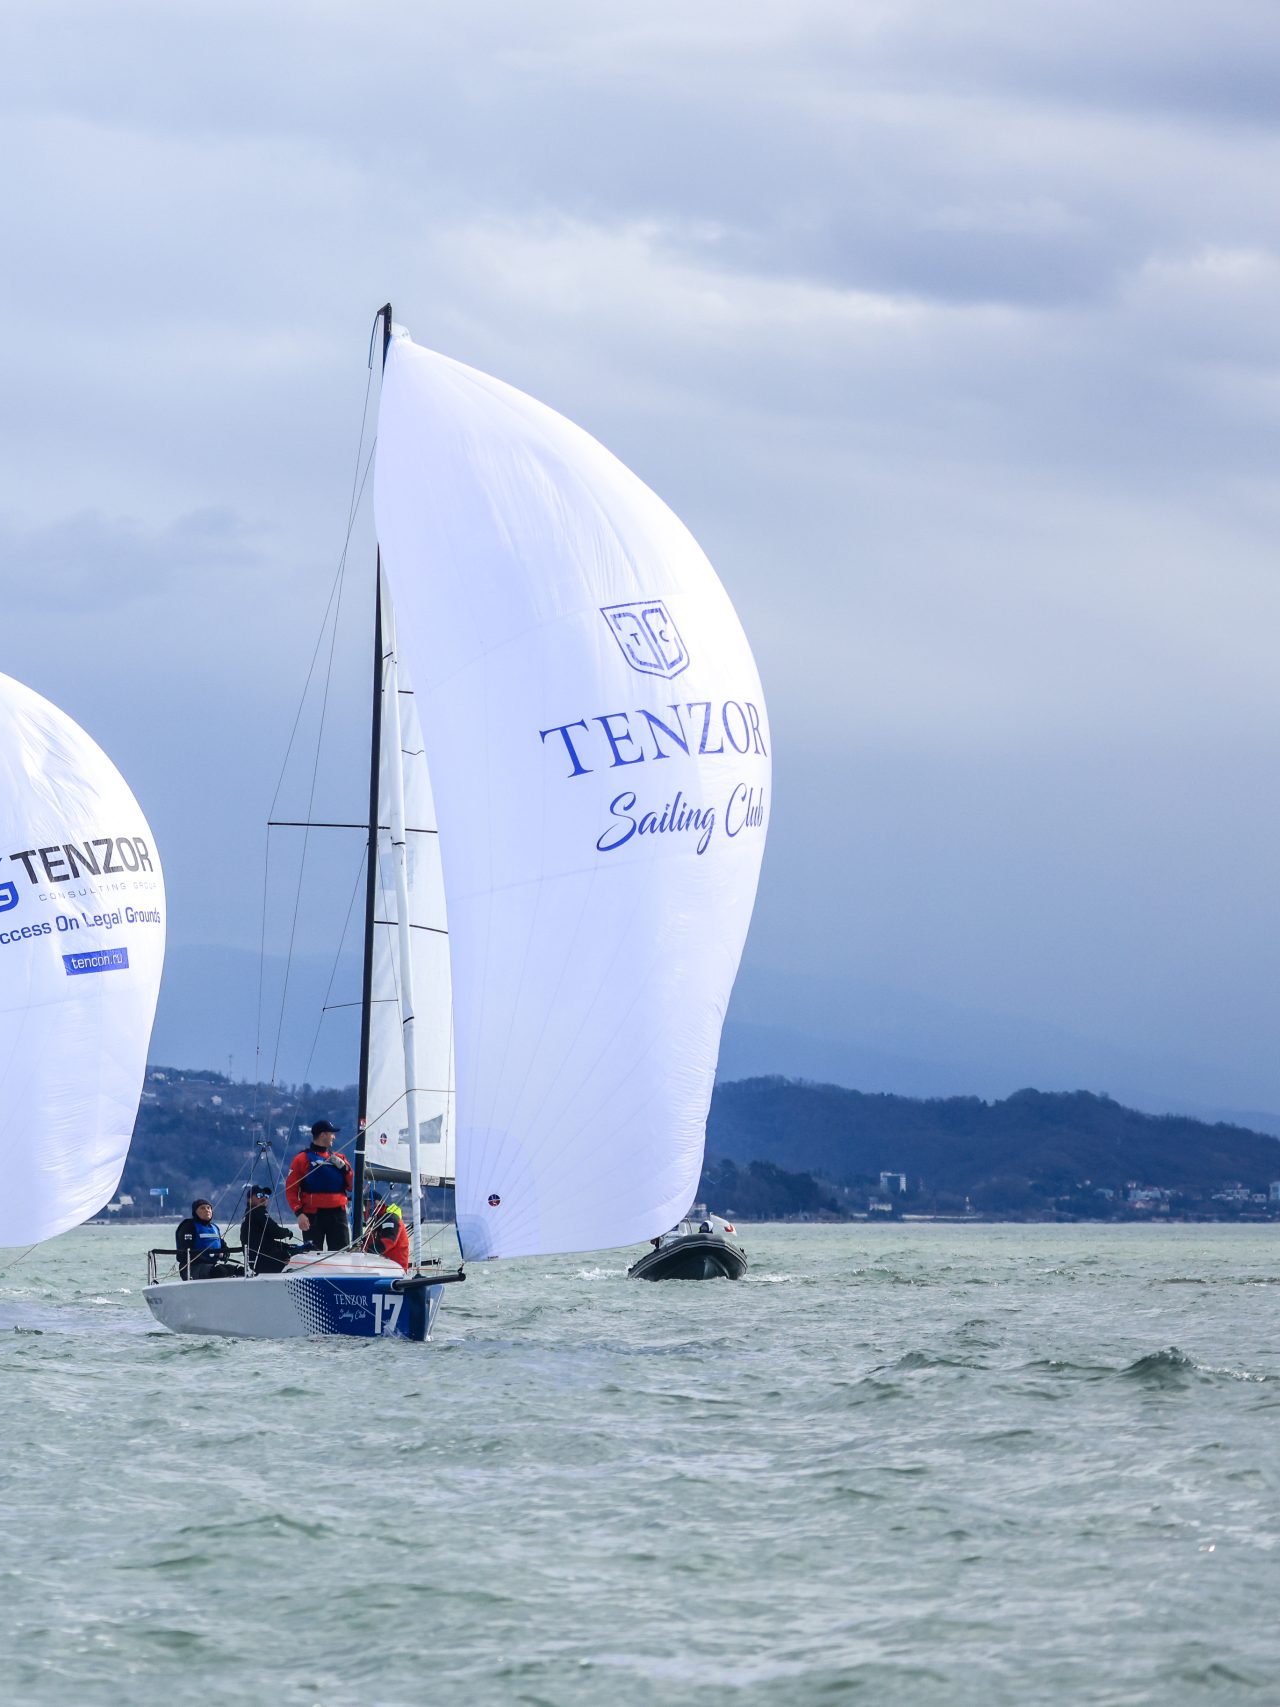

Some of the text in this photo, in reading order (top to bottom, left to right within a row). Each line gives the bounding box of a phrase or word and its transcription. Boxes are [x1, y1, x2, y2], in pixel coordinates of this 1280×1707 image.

[539, 700, 767, 779] TENZOR
[596, 782, 764, 855] Sailing Club
[9, 837, 153, 884] TENZOR
[38, 882, 126, 902] CONSULTING
[56, 915, 80, 932] On
[82, 908, 123, 930] Legal
[125, 906, 161, 924] Grounds
[71, 952, 123, 970] tencon.ru
[333, 1294, 368, 1306] TENZOR
[372, 1294, 404, 1334] 17
